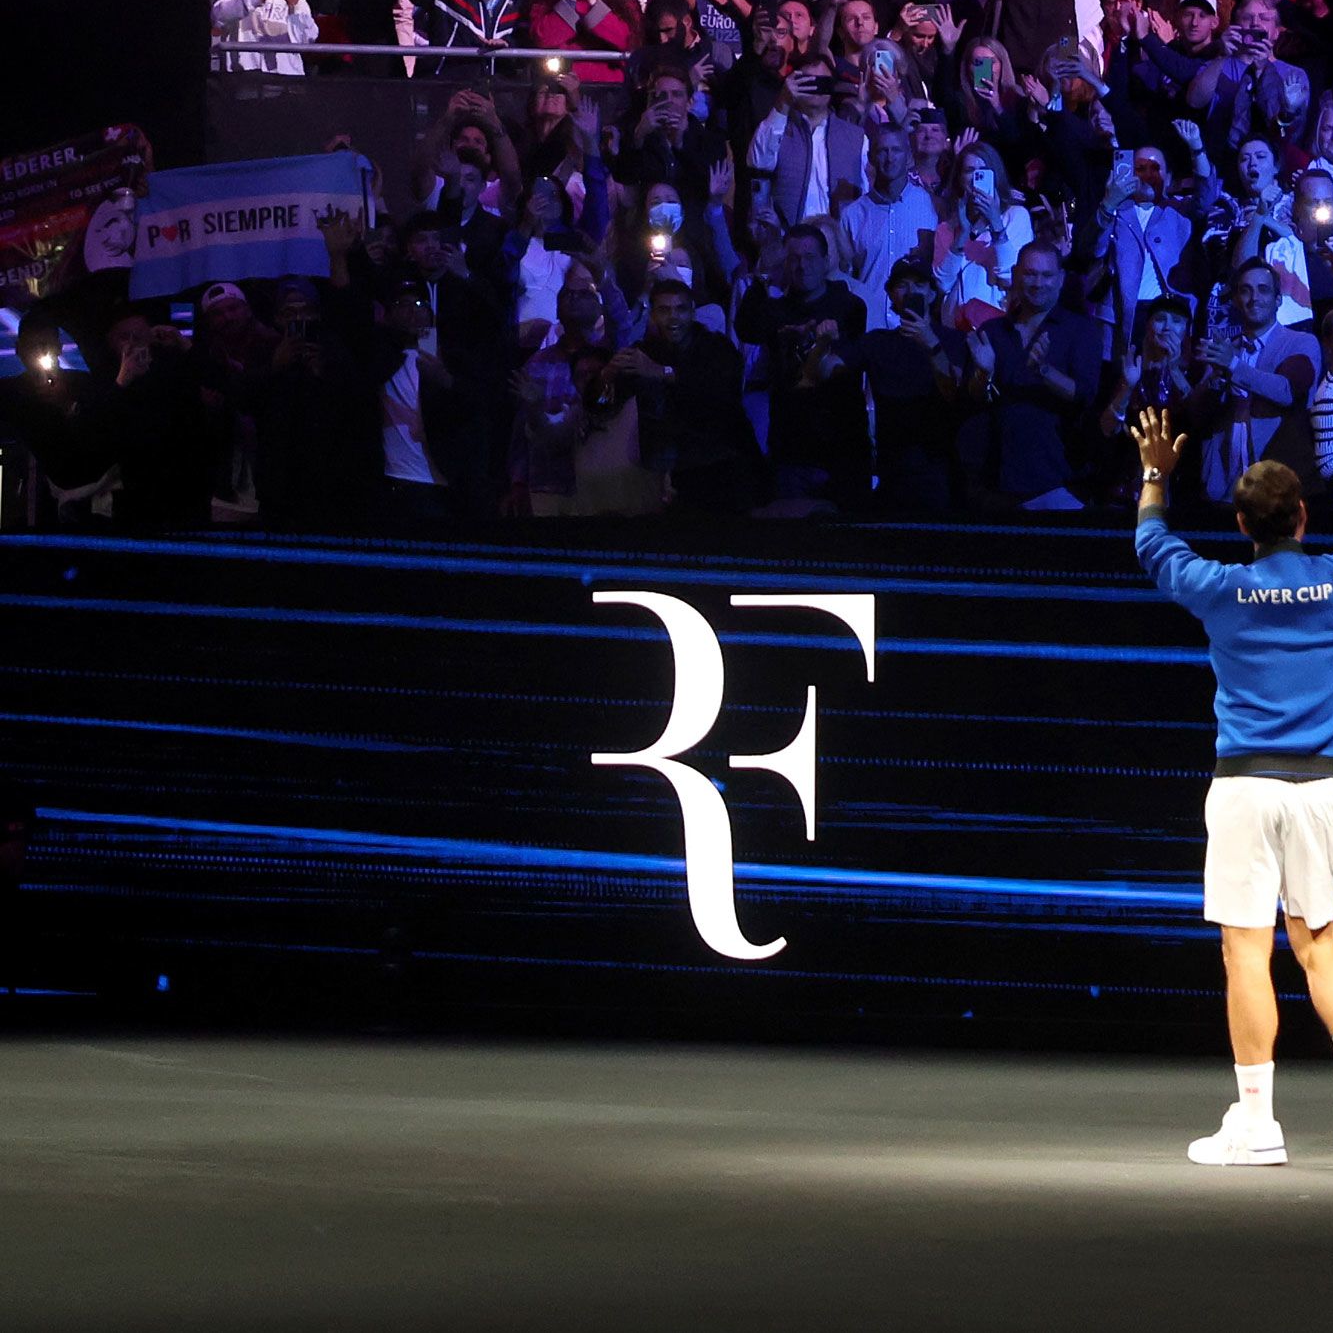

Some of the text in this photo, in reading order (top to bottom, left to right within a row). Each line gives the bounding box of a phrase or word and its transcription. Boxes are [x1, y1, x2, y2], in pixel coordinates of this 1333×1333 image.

[203, 204, 300, 235] SIEMPRE
[1237, 582, 1333, 605] LAVER CUP
